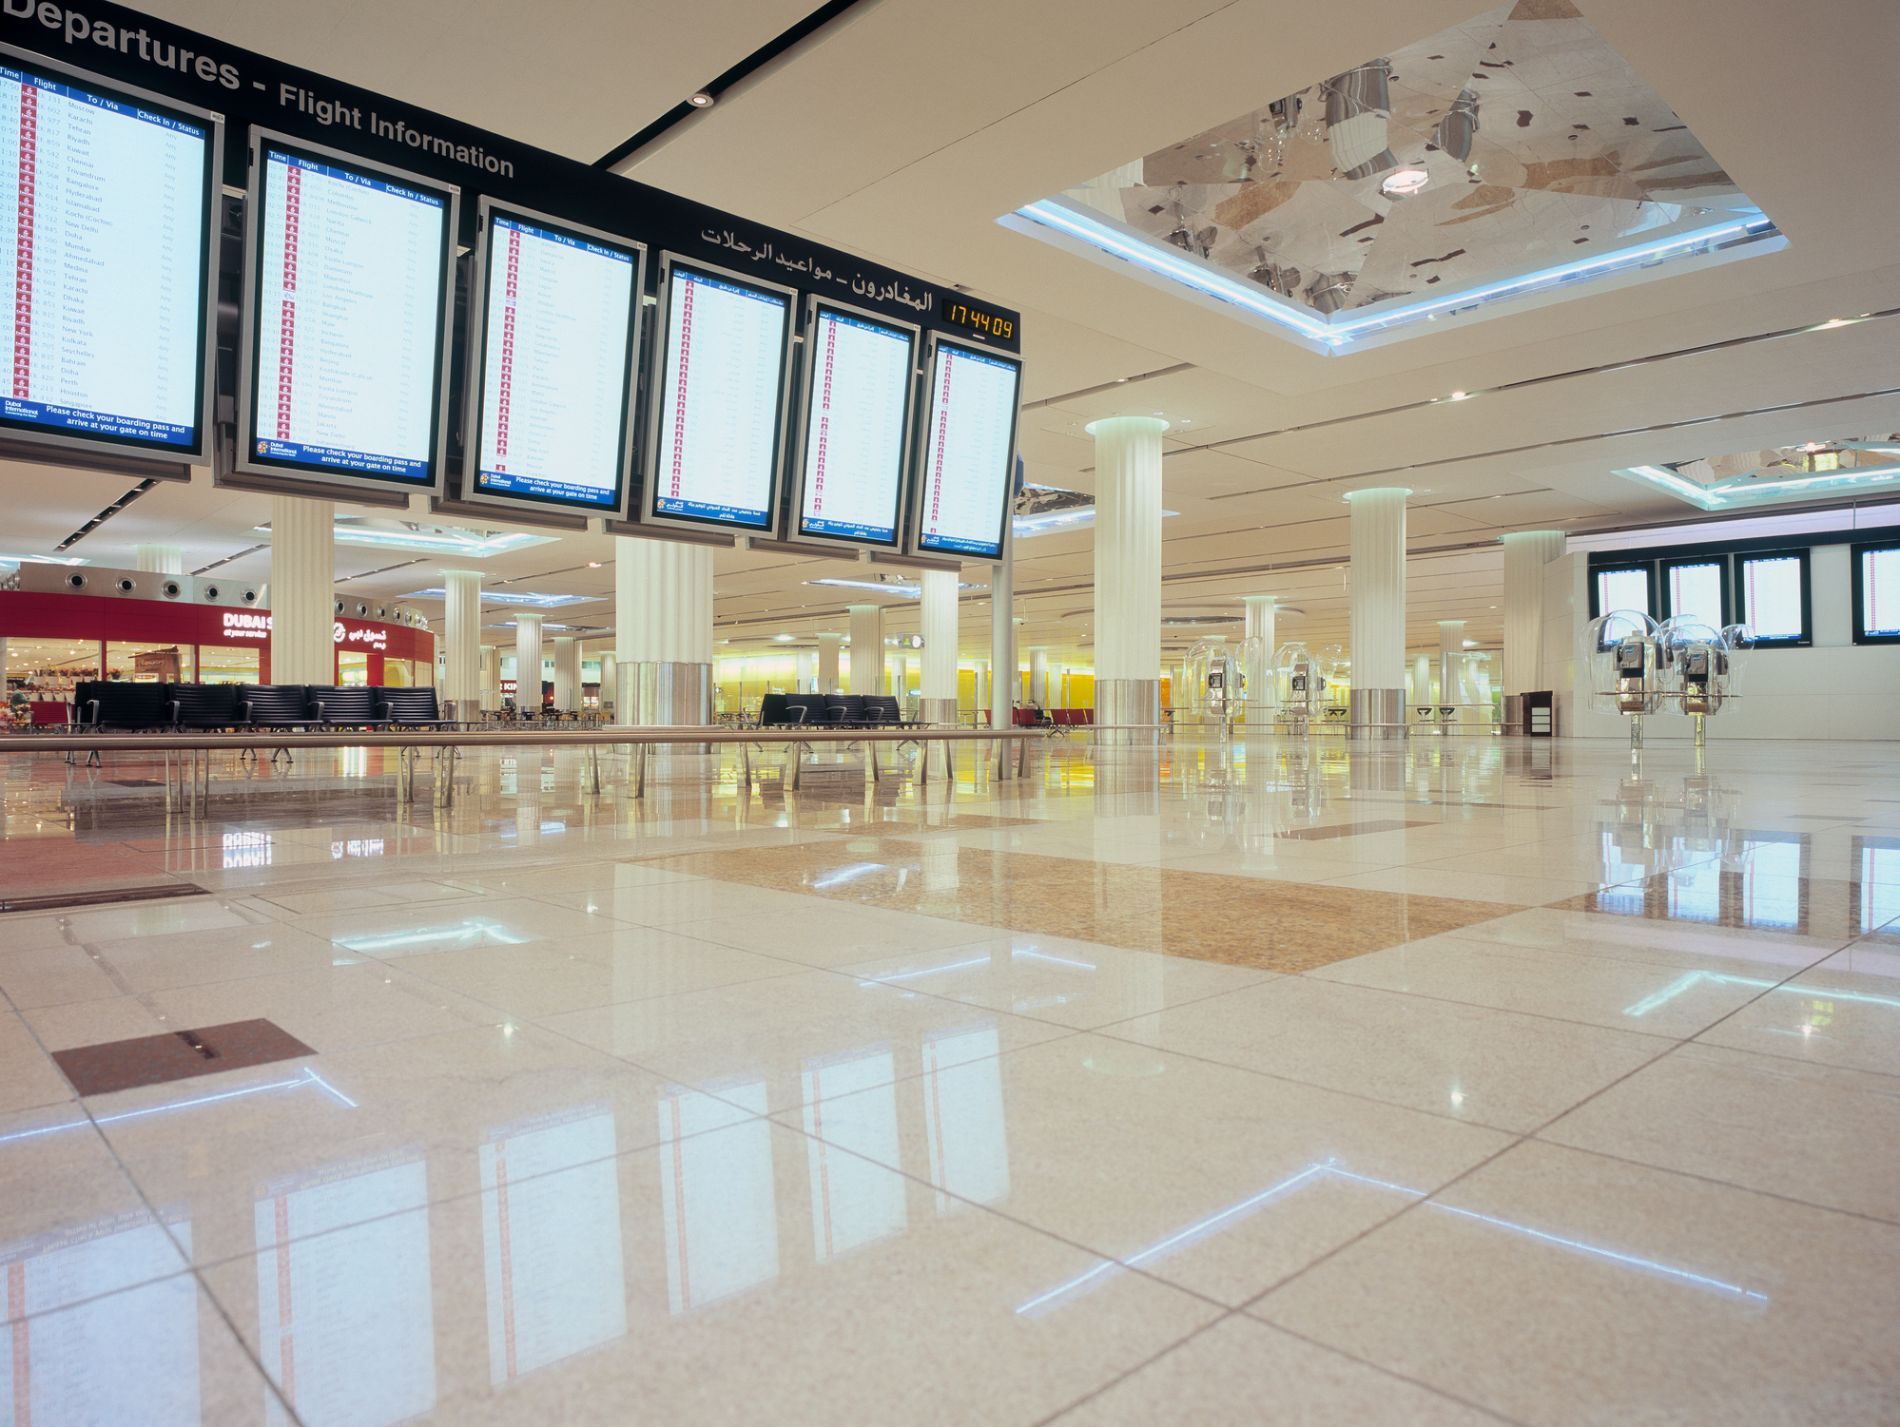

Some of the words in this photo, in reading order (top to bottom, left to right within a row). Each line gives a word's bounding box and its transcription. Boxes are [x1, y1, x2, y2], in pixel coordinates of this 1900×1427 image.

[0, 67, 18, 79] Time
[3, 0, 240, 90] Departures
[280, 83, 362, 129] Flight
[371, 111, 514, 178] Information
[34, 77, 55, 91] Flight
[87, 94, 97, 104] To
[106, 100, 118, 110] Via
[138, 110, 160, 123] Check
[178, 123, 199, 135] Status
[270, 153, 286, 162] Time
[298, 160, 318, 171] Flight
[361, 178, 370, 186] Via
[387, 185, 405, 195] Check
[420, 195, 438, 205] Status
[518, 224, 533, 234] Flight
[701, 227, 772, 261] الرحلات
[588, 245, 602, 254] Check
[614, 252, 628, 261] Status
[775, 253, 832, 281] مواعيد
[851, 271, 932, 312] المغادرون
[951, 304, 965, 324] 17
[971, 309, 988, 330] 44
[992, 318, 1013, 339] 09
[46, 405, 69, 415] Please
[72, 409, 93, 418] check
[96, 413, 114, 423] your
[116, 416, 150, 428] boarding
[152, 422, 169, 431] pass
[67, 417, 88, 427] arrive
[100, 422, 117, 433] your
[119, 425, 136, 436] gate
[138, 428, 148, 436] on
[150, 430, 167, 439] time
[303, 445, 324, 453] Please
[326, 448, 345, 456] check
[347, 451, 361, 459] your
[364, 453, 391, 464] boarding
[393, 458, 407, 466] pass
[321, 455, 339, 463] arrive
[350, 459, 364, 468] your
[366, 462, 380, 470] gate
[529, 485, 545, 493] arrive
[552, 489, 564, 497] your
[550, 482, 562, 490] your
[563, 483, 585, 493] boarding
[223, 613, 265, 629] DUBAI
